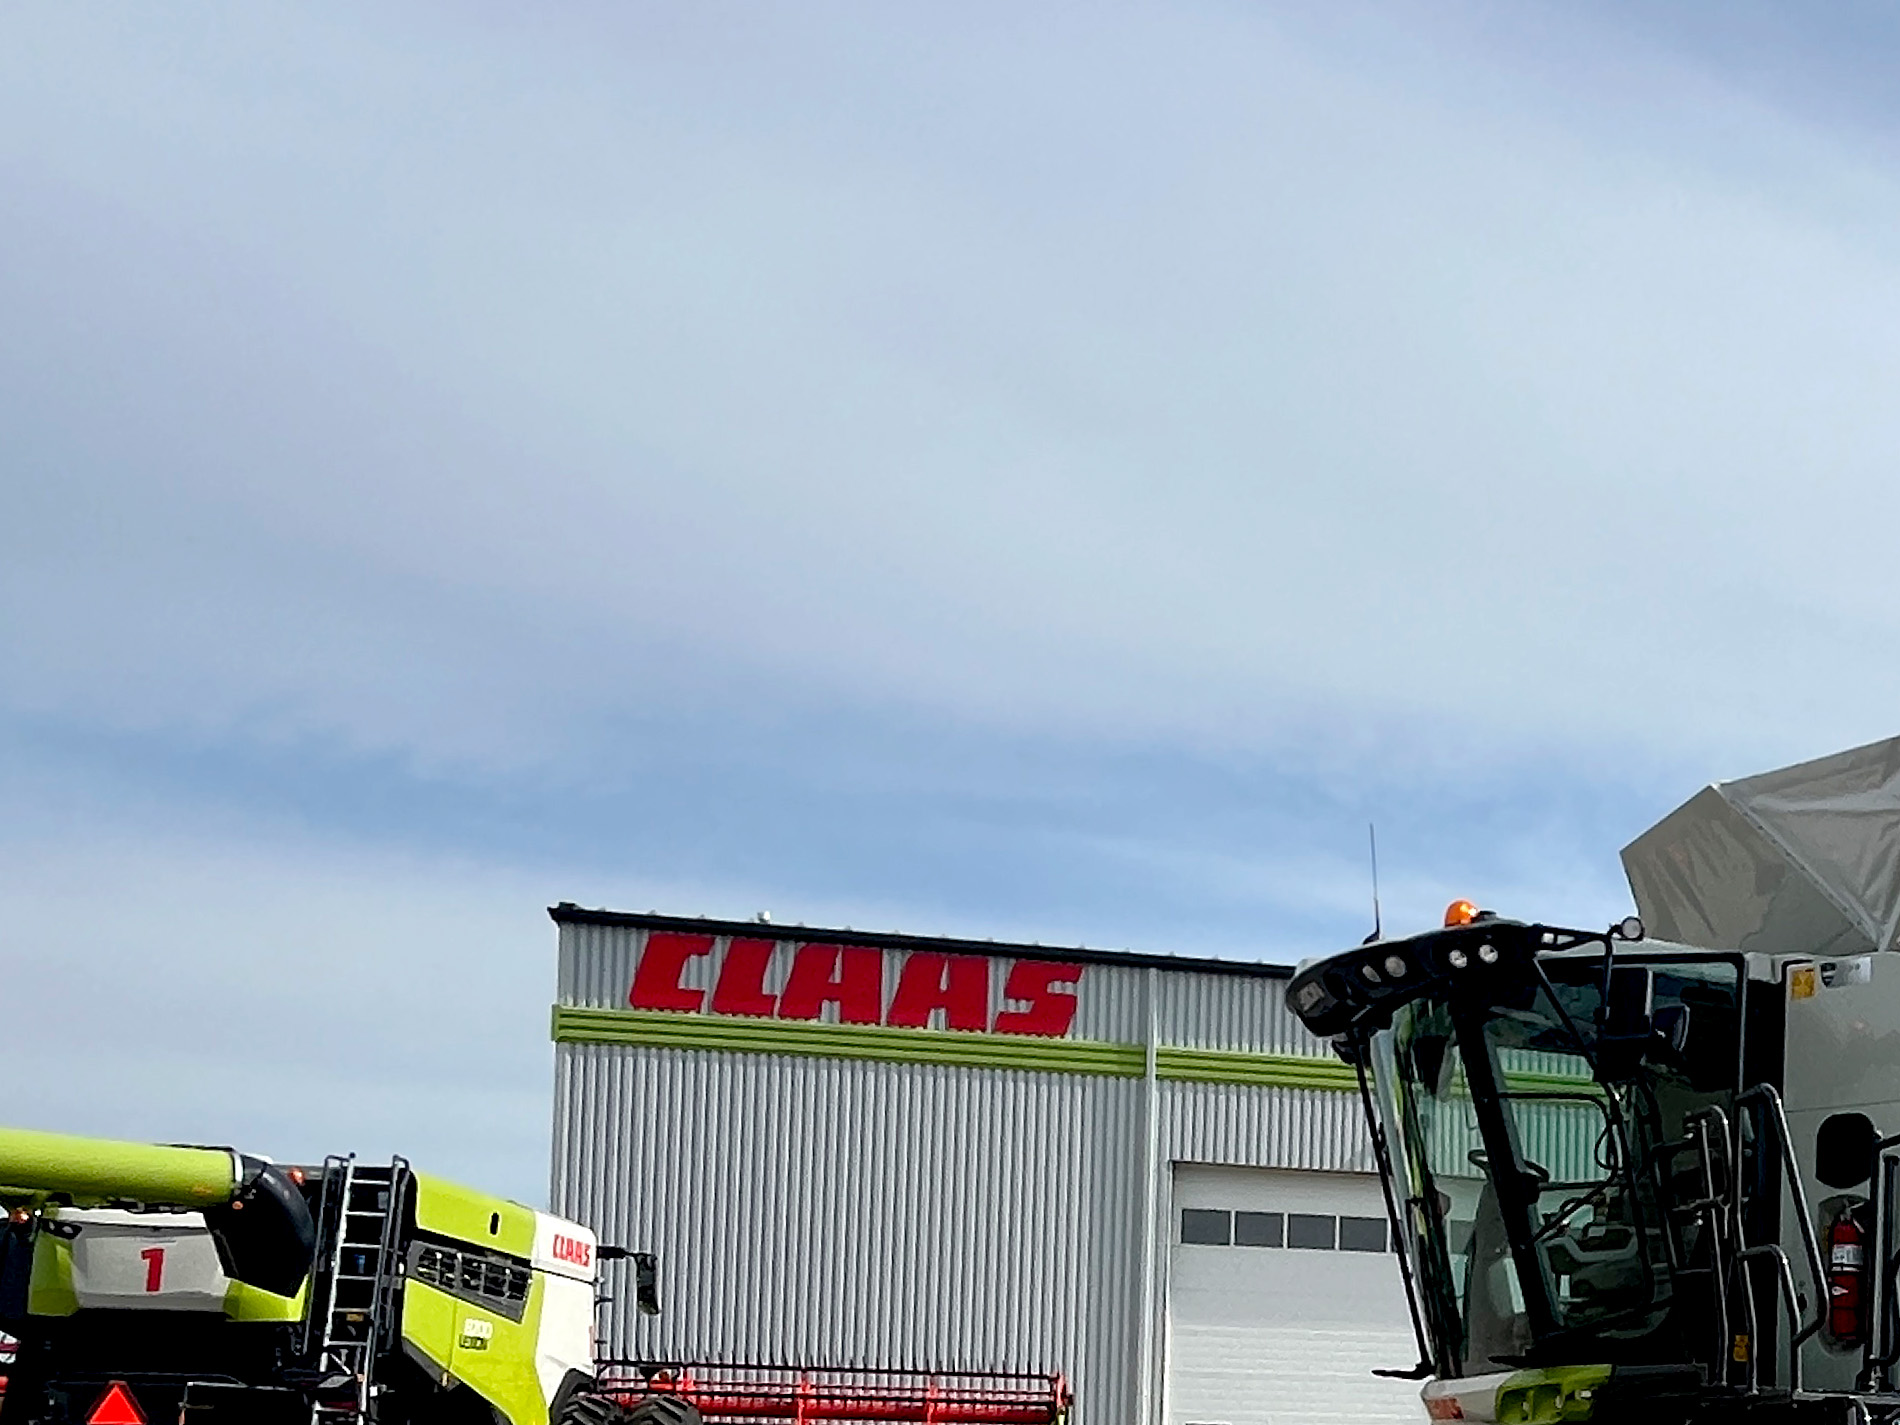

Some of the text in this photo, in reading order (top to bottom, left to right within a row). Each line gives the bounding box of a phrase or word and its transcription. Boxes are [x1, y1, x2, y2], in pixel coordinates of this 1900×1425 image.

[630, 932, 1082, 1038] CLAAS
[141, 1248, 165, 1292] 1
[553, 1233, 591, 1267] CLAAS
